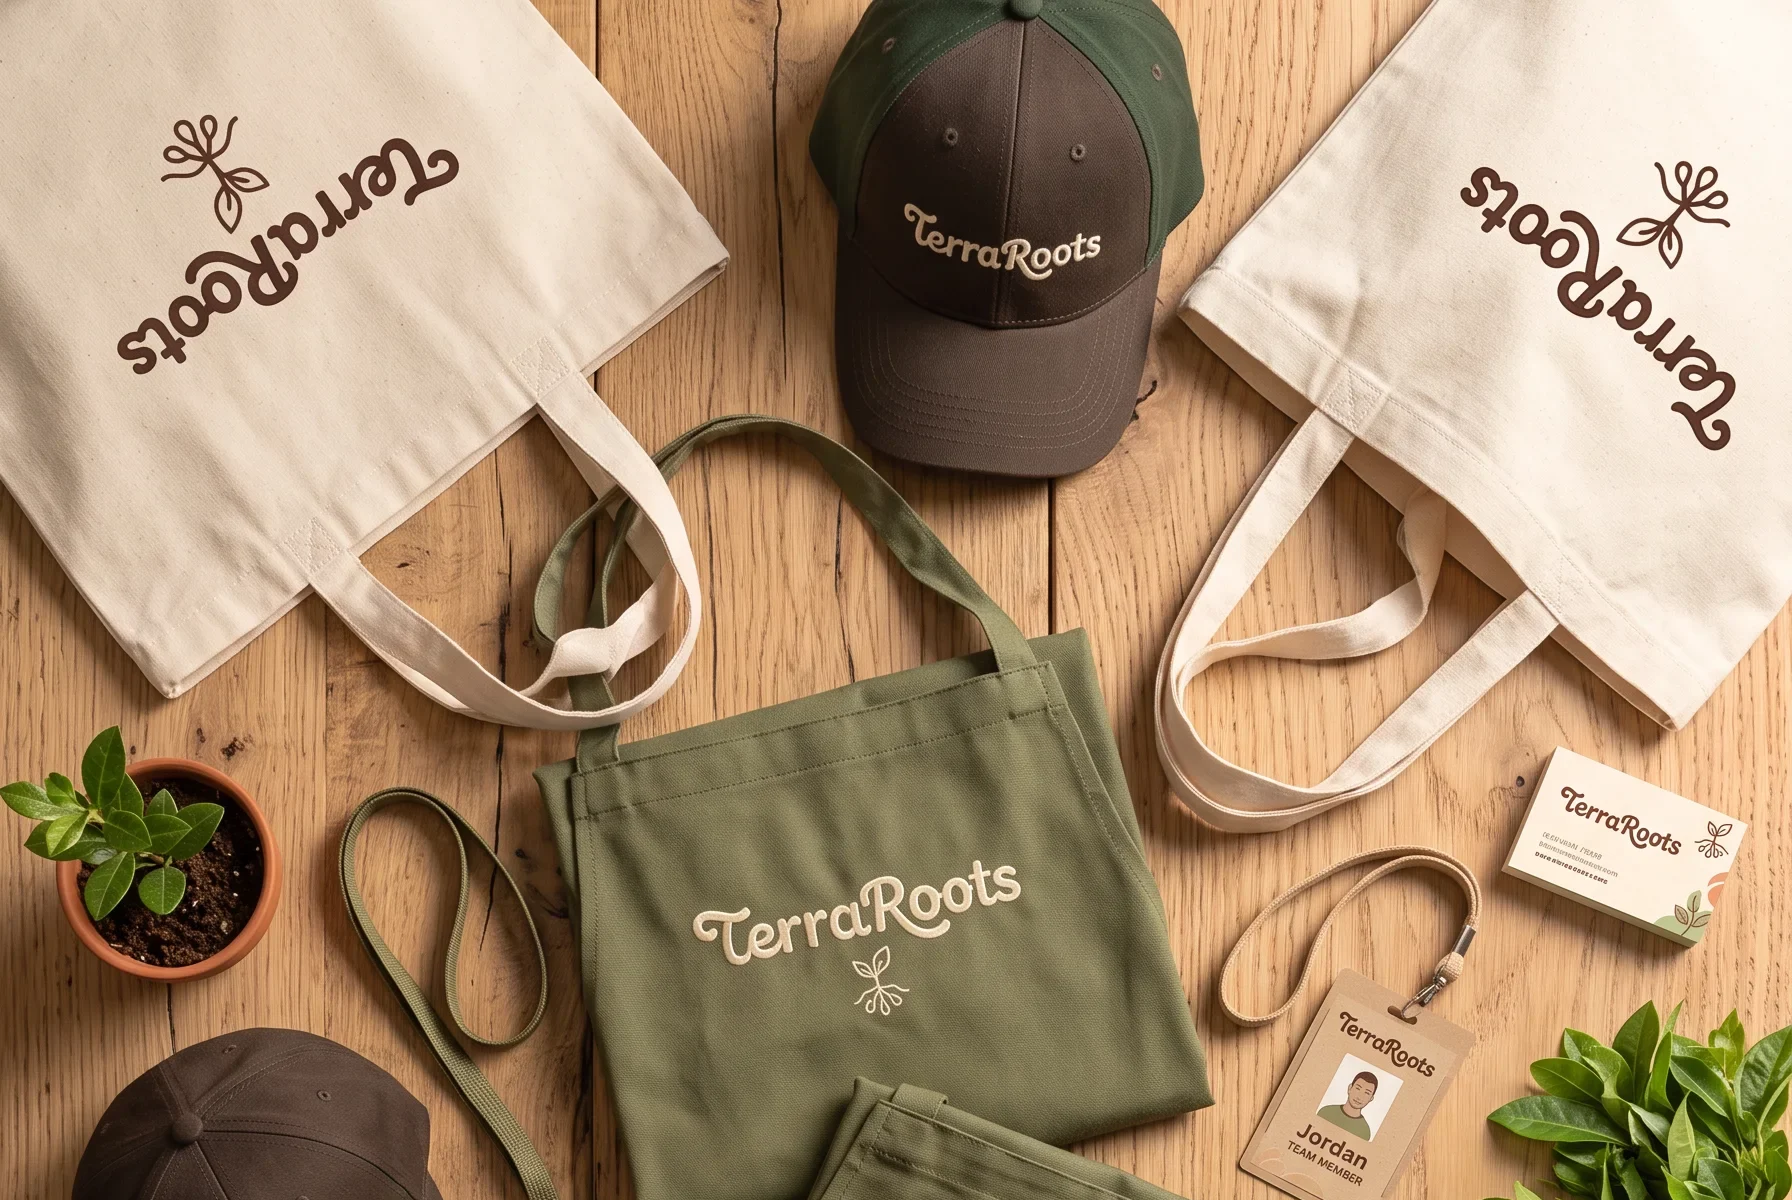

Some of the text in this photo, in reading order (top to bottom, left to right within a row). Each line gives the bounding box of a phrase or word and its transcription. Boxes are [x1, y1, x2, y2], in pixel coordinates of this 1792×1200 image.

[117, 137, 460, 375] TerraRoots
[904, 203, 1101, 281] TerraRoots
[1460, 166, 1736, 451] TerraRoots
[1561, 786, 1682, 856] TerraRoots
[693, 860, 1021, 966] TerraRoots
[1339, 1011, 1436, 1077] TerraRoots
[1287, 1140, 1363, 1187] TEAM MEMBER
[1297, 1125, 1368, 1170] Jordan
